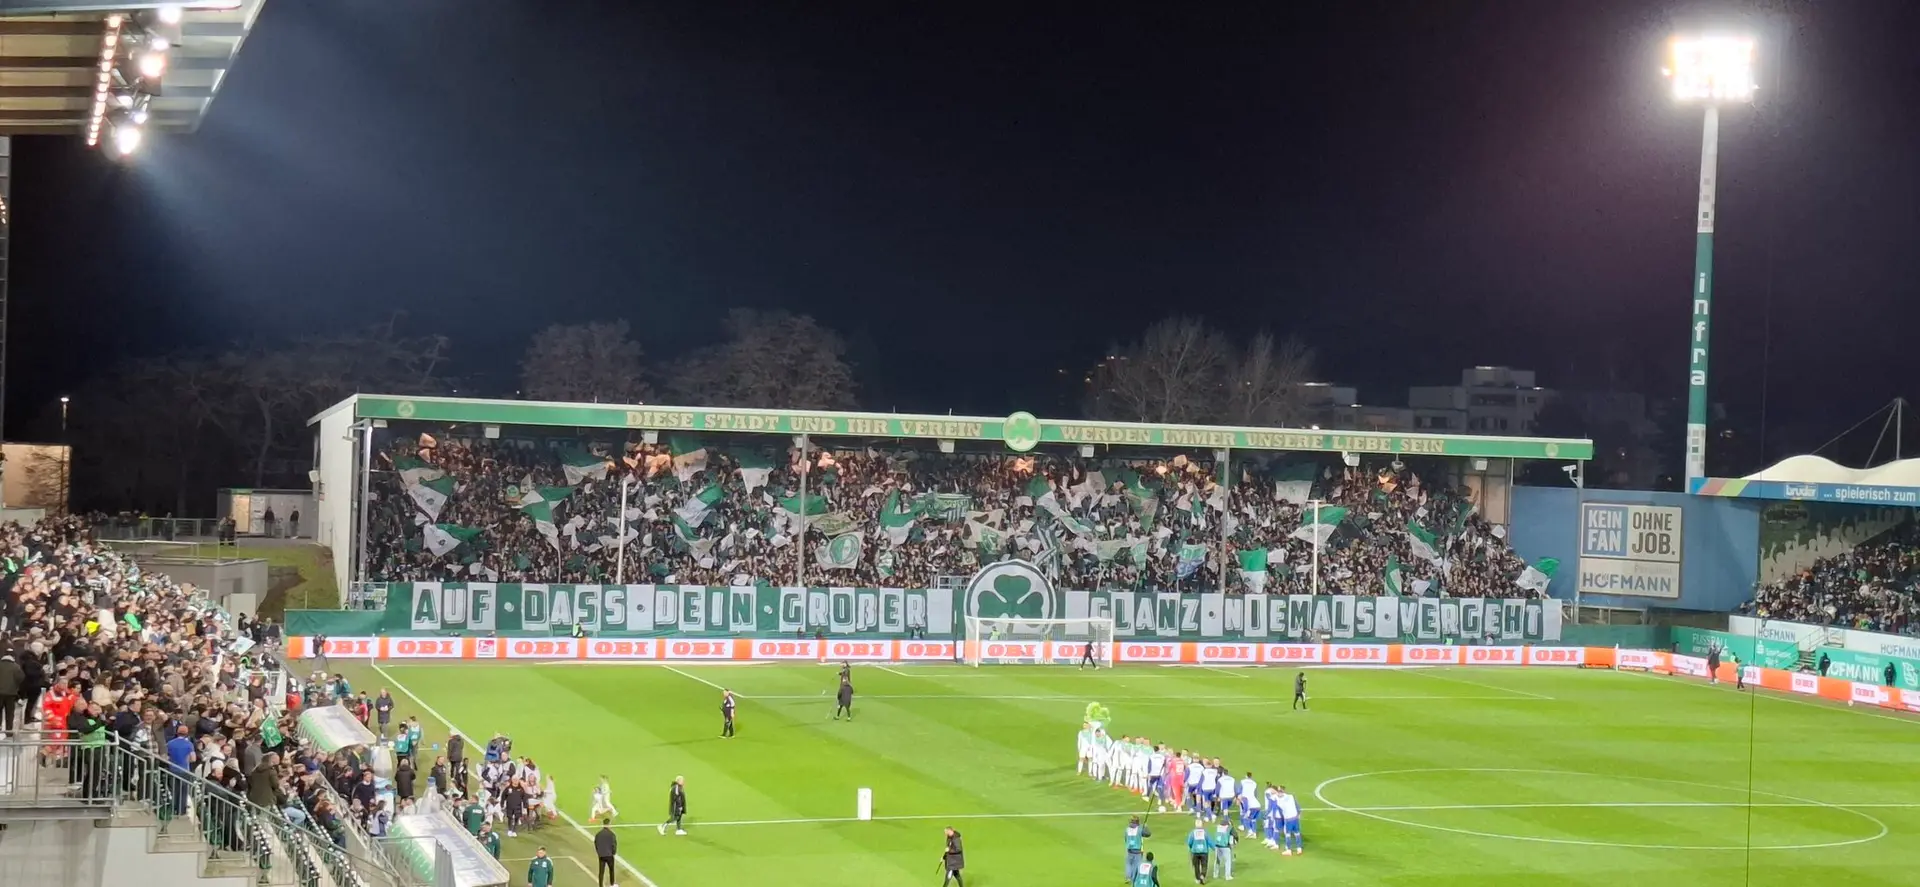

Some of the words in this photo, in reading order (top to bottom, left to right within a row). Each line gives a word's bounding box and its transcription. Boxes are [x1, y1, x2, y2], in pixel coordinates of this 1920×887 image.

[1690, 272, 1708, 386] infra
[625, 410, 694, 428] DIESE
[704, 413, 779, 431] STADT
[790, 416, 836, 433] UND
[847, 418, 889, 435] IHR
[900, 419, 983, 437] VEREIN
[1060, 426, 1151, 443] WERDEN
[1162, 430, 1236, 446] IMMER
[1246, 432, 1324, 449] UNSERE
[1332, 435, 1392, 451] LIEBE
[1402, 438, 1444, 453] SEIN
[1786, 484, 1816, 498] bruder
[1835, 486, 1890, 501] spielerisch
[1894, 491, 1916, 502] zum
[1588, 509, 1622, 529] KEIN
[1632, 512, 1673, 531] OHNE
[1587, 529, 1621, 552] FAN
[1631, 532, 1676, 555] JOB.
[1582, 572, 1672, 592] HOFMANN
[413, 588, 493, 625] AUF
[523, 590, 626, 626] DASS
[654, 591, 754, 626] DEIN
[1090, 596, 1199, 631] GLANZ
[1224, 597, 1376, 632] NIEMALS
[1399, 602, 1543, 635] VERGEHT
[1758, 628, 1796, 641] HOFMANN
[396, 641, 453, 655] OBI
[514, 641, 569, 655] OBI
[595, 642, 649, 655] OBI
[672, 643, 724, 656] OBI
[758, 643, 811, 656] OBI
[833, 643, 885, 656] OBI
[907, 643, 954, 656] OBI
[988, 644, 1036, 657] OBI
[1127, 645, 1174, 658] OBI
[1203, 645, 1250, 658] OBI
[1270, 646, 1314, 659] OBI
[1335, 646, 1381, 659] OBI
[1409, 647, 1453, 660] OBI
[1473, 648, 1517, 660] OBI
[1535, 649, 1578, 661] OBI
